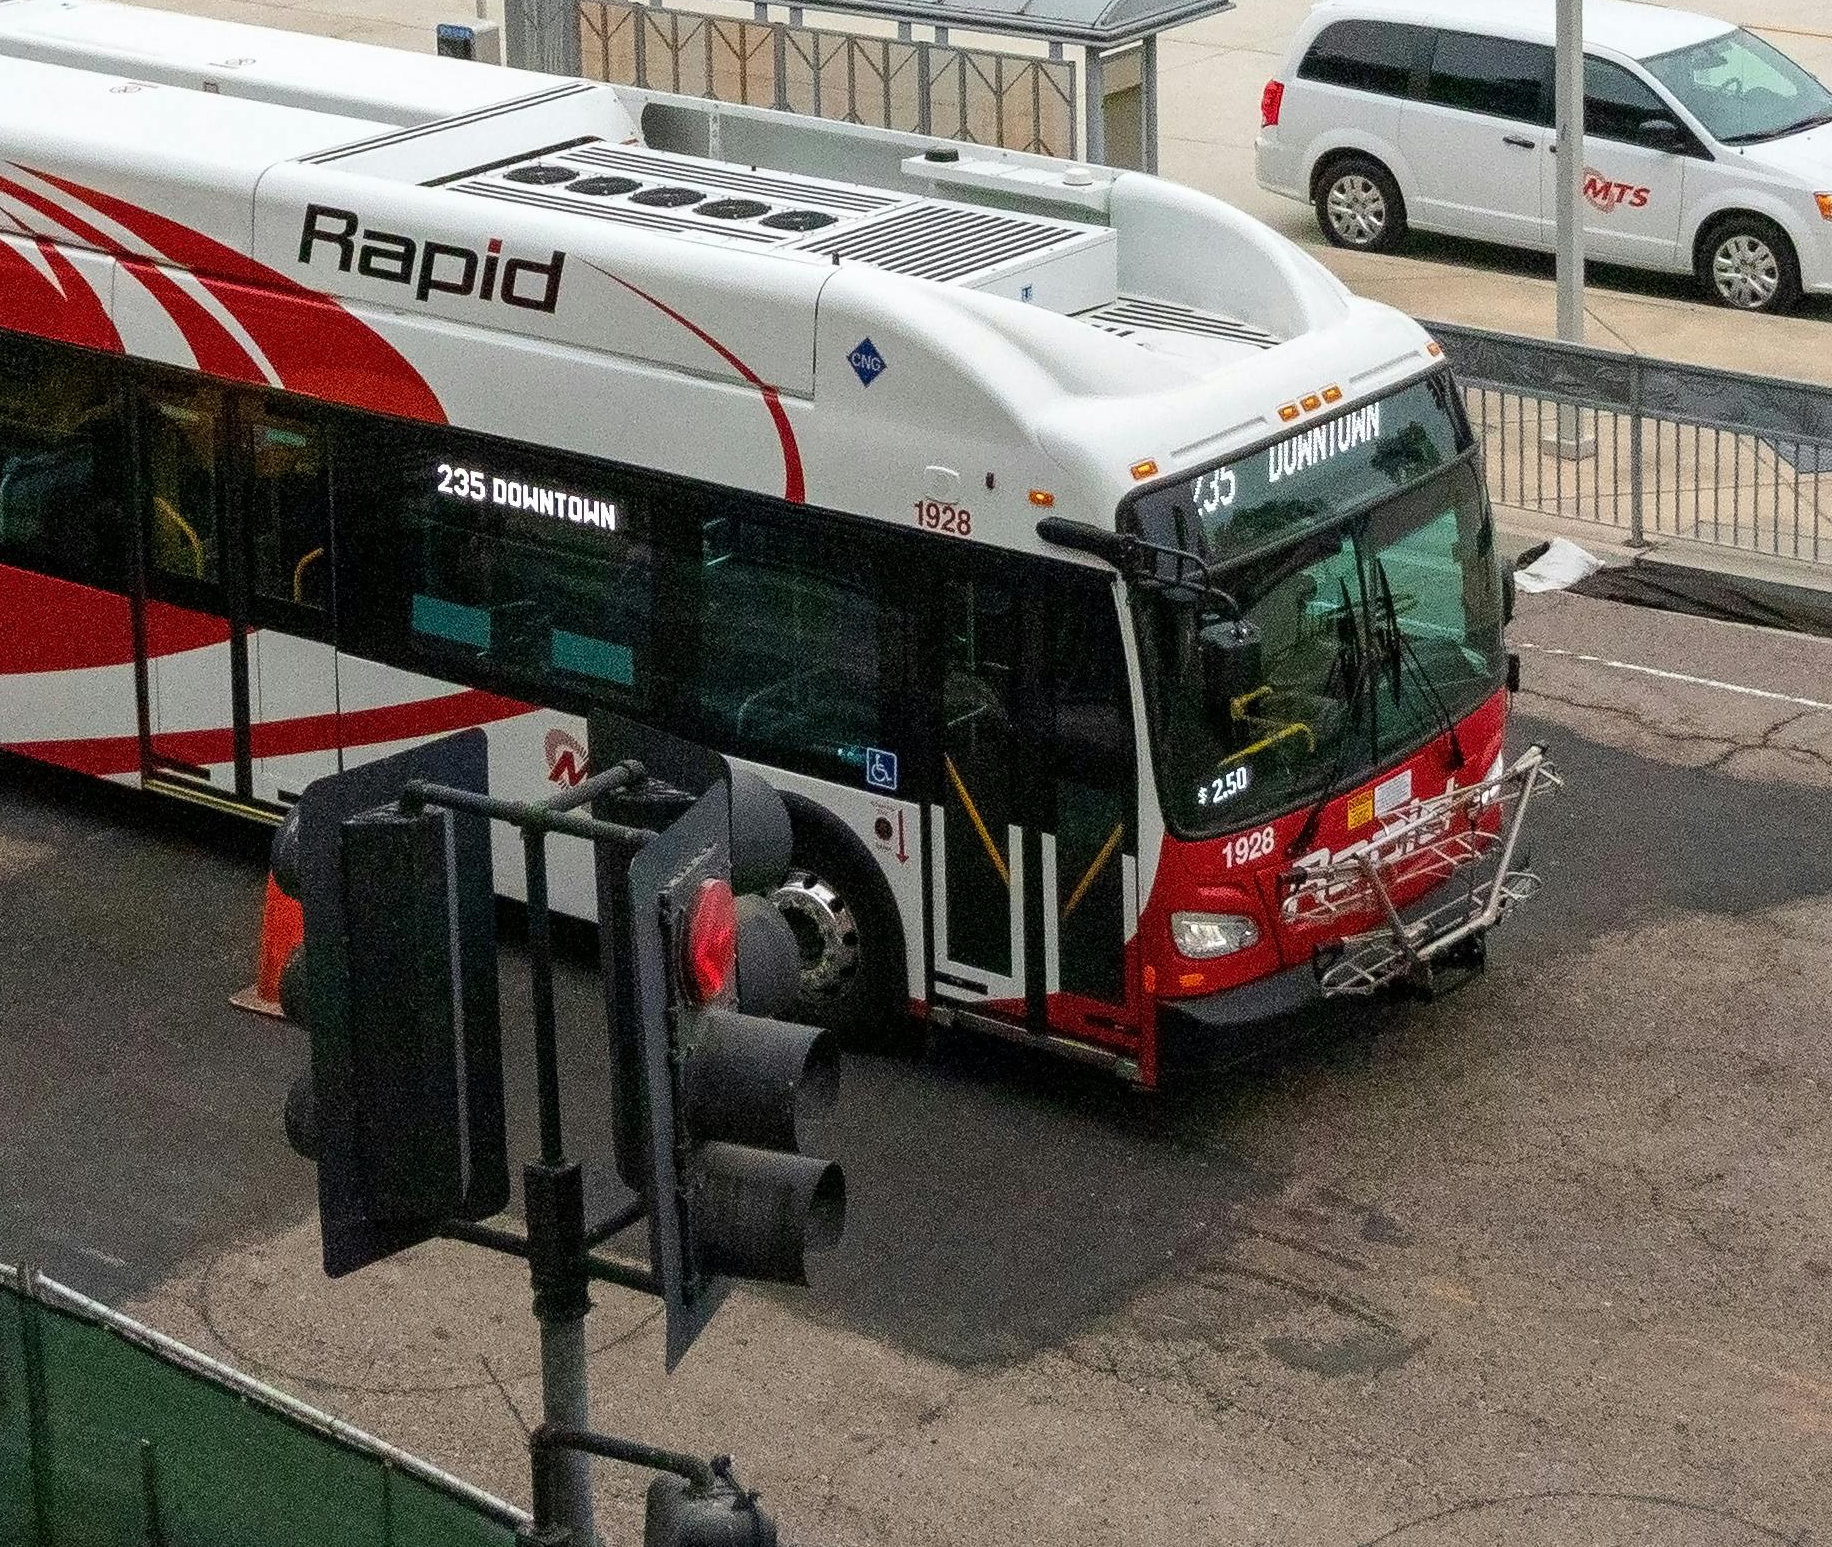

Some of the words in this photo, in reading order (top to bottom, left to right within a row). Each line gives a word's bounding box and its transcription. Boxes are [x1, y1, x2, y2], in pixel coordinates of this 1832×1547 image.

[1584, 177, 1651, 208] MTS
[298, 203, 567, 314] Rapid
[851, 352, 882, 371] CNG
[436, 463, 487, 501] 235
[492, 477, 616, 531] DOWNTOWN
[914, 499, 972, 536] 1928
[1221, 825, 1275, 869] 1928
